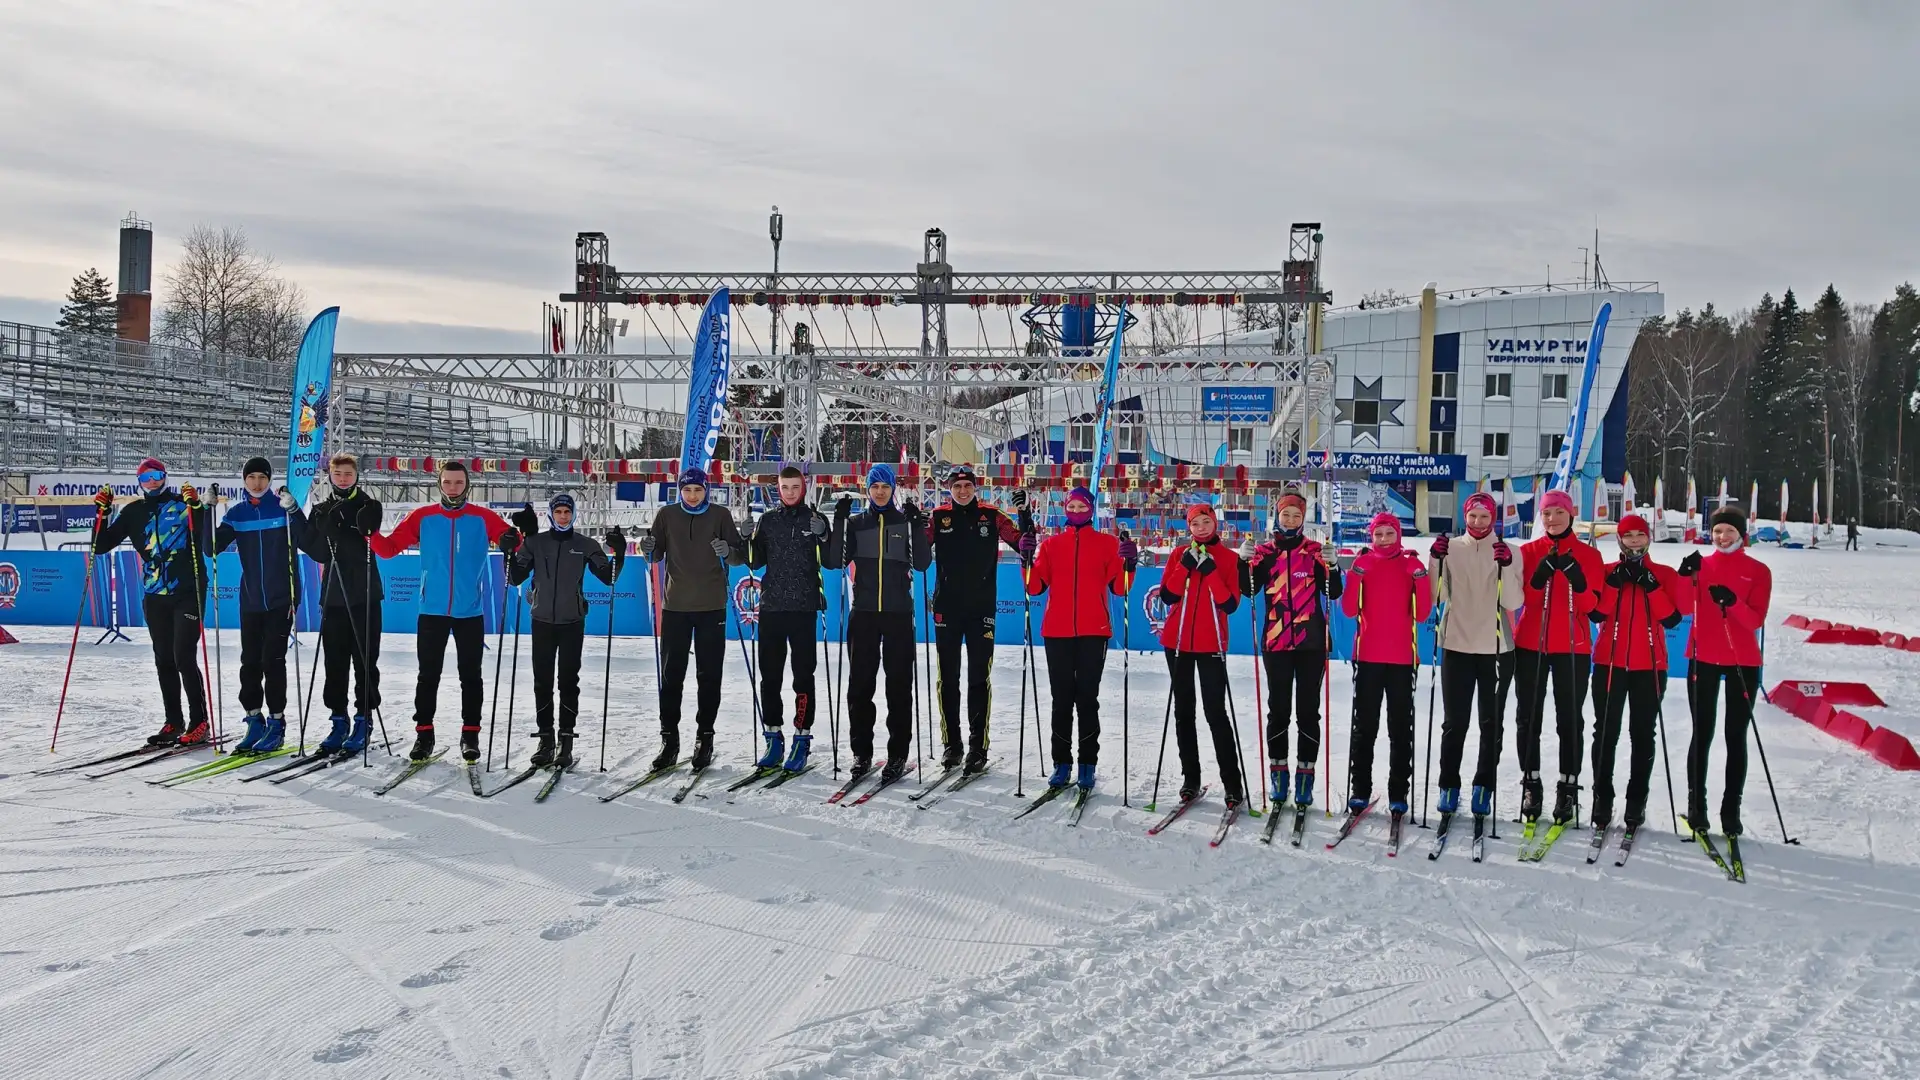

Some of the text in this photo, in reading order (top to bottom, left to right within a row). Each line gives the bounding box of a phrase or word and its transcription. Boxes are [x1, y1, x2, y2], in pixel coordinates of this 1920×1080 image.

[1487, 355, 1554, 364] ТЕРРИТОРИЯ
[484, 460, 494, 469] 14
[1350, 454, 1400, 465] КОМПЛЕКС
[530, 460, 540, 470] 13
[723, 462, 732, 472] 9
[1398, 464, 1450, 476] КУЛАКОВОЙ
[920, 468, 930, 476] 7
[1073, 465, 1082, 476] 4
[1128, 465, 1136, 476] 3
[66, 518, 96, 527] SMART
[1804, 686, 1816, 694] 32
